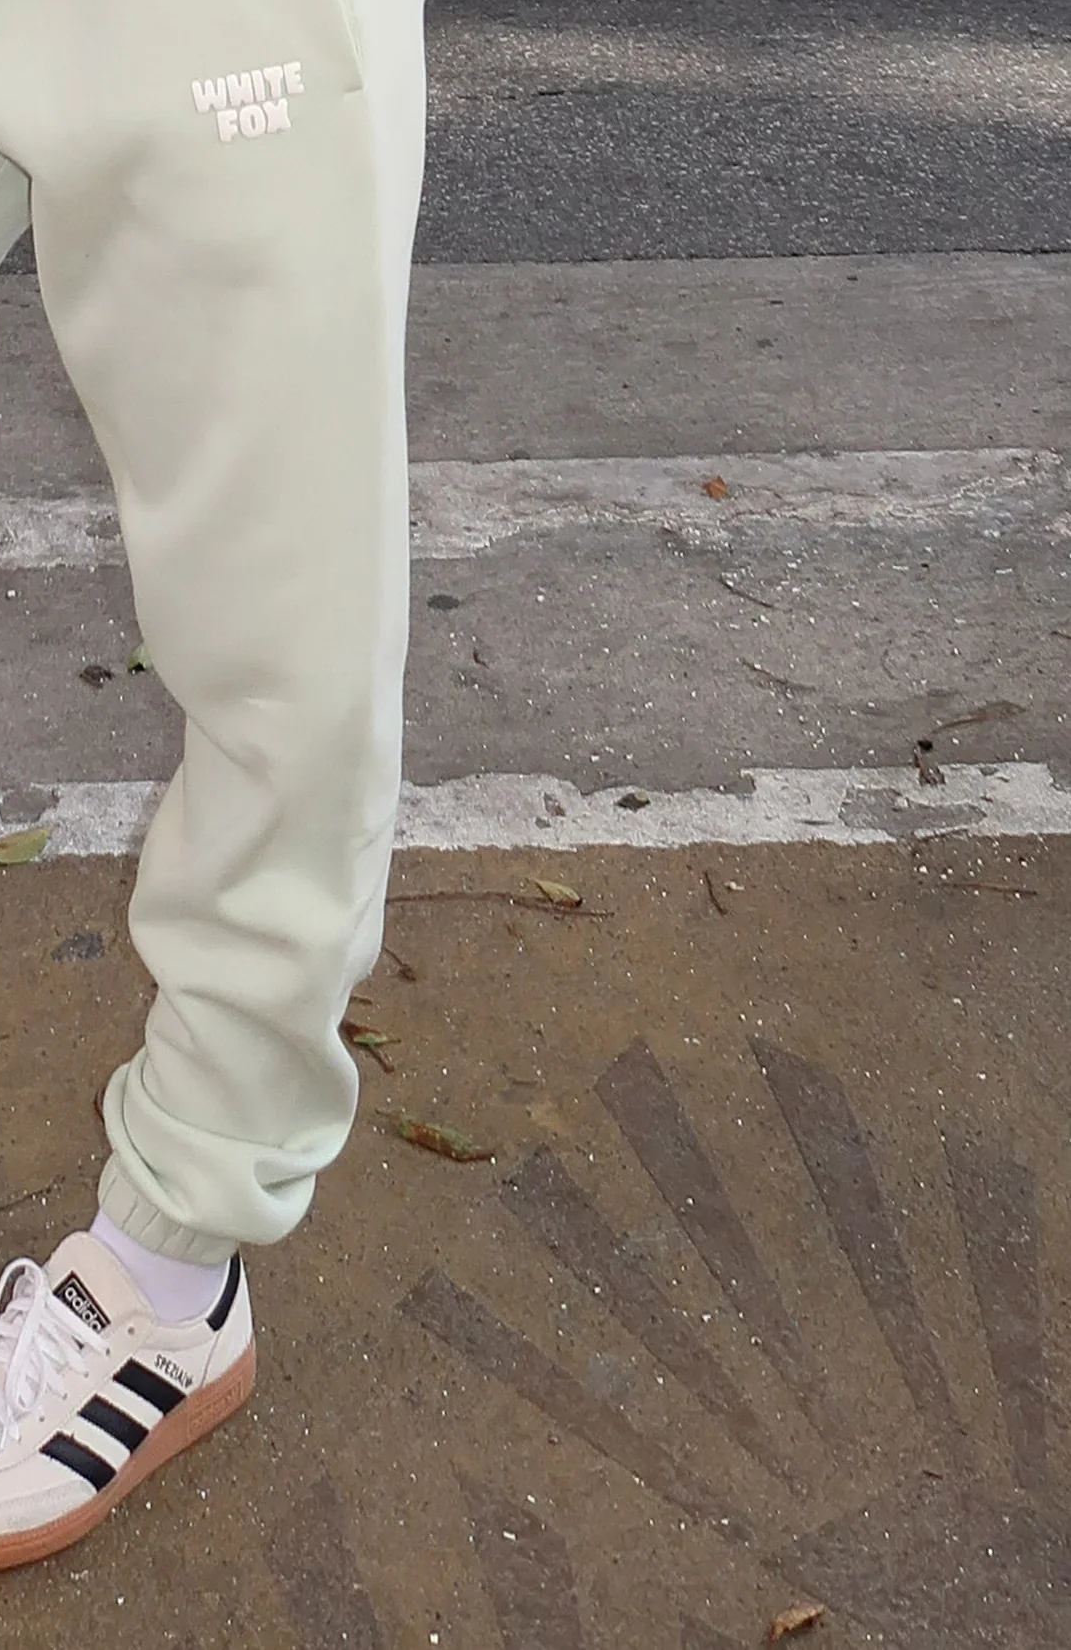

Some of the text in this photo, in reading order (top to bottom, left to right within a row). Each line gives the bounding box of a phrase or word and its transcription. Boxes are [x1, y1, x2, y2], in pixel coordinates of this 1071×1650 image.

[191, 61, 305, 114] WHITE
[216, 98, 292, 143] FOX
[64, 1286, 102, 1334] adida
